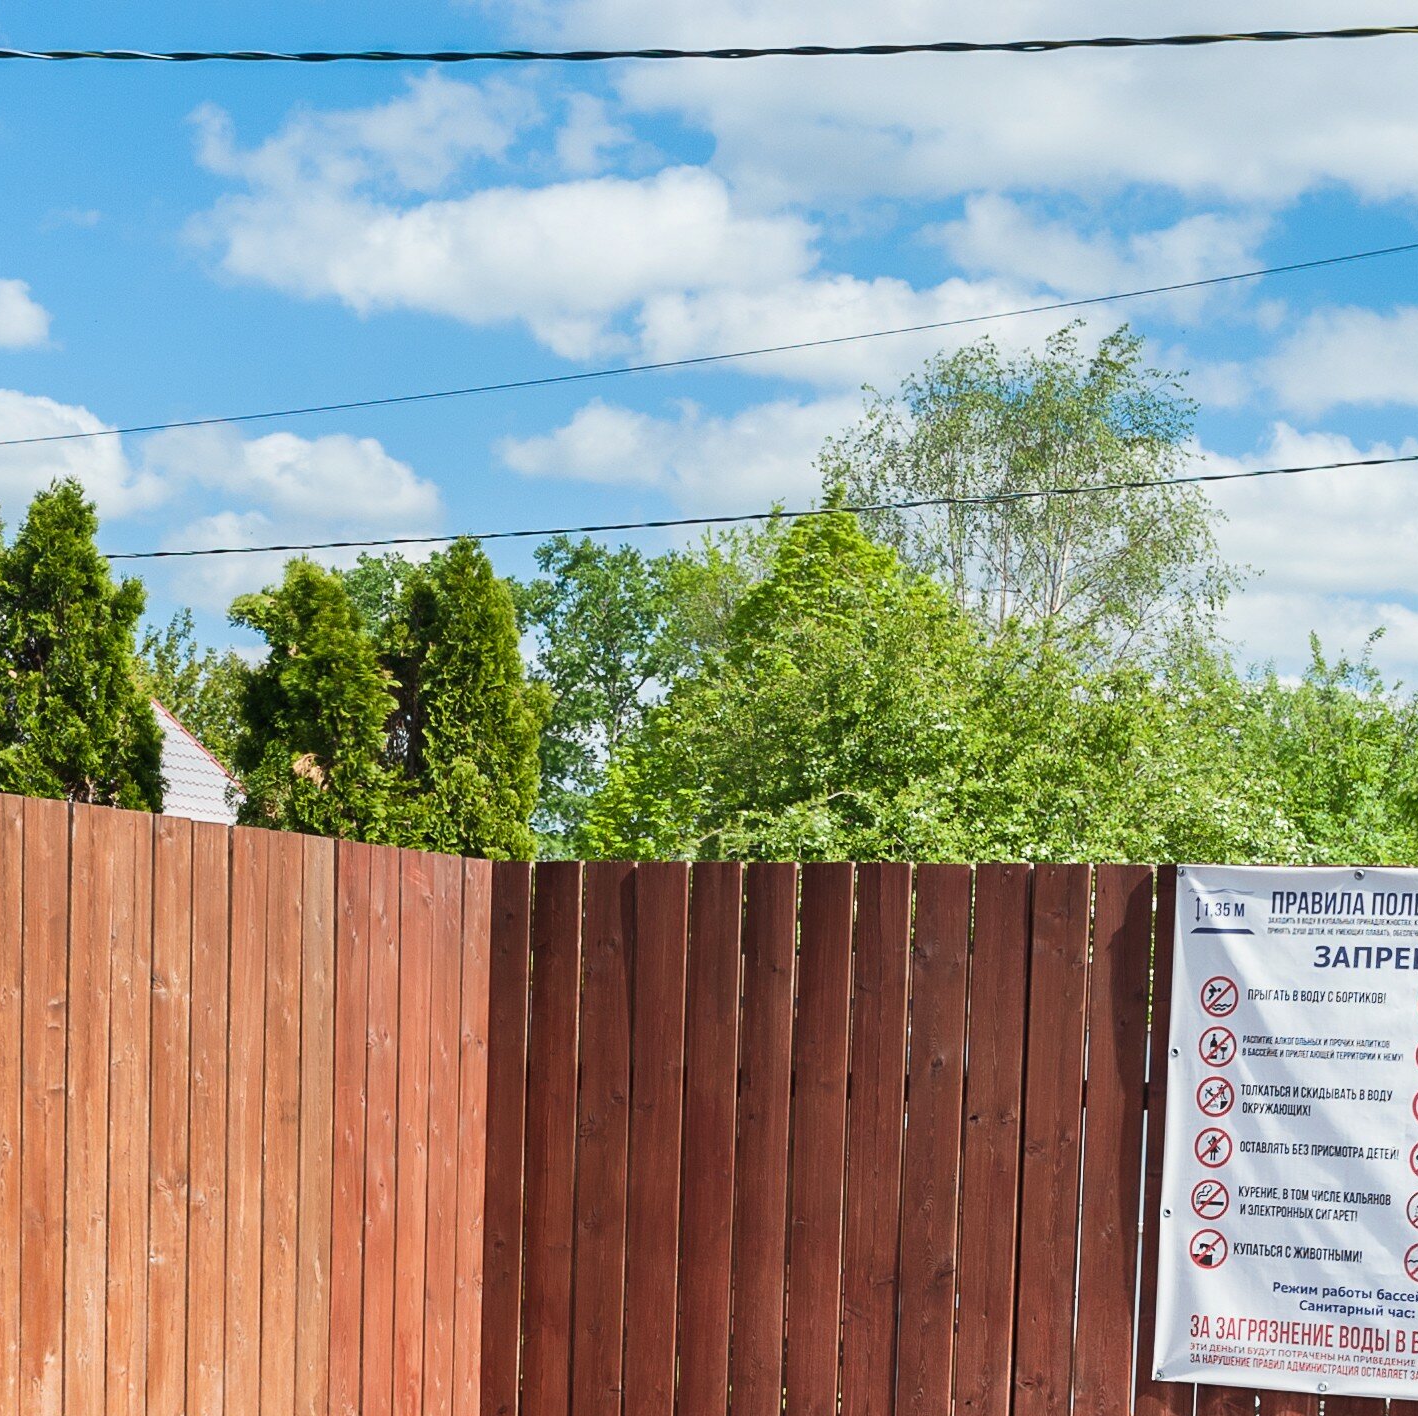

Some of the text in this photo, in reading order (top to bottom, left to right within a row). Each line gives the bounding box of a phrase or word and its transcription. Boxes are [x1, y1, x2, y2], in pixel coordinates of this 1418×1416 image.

[1203, 902, 1245, 918] 1,35 М
[1271, 890, 1364, 915] ПРАВИЛА
[1247, 988, 1386, 1004] ПРЫГАТЬ В ВОДУ С БОРТИКОВ!
[1242, 1035, 1390, 1048] РАСПИТИЕ АЛКОГОЛЬНЫХ И ПРОЧИХ НАПИТКОВ
[1247, 1049, 1279, 1058] БАССЕЙНЕ
[1279, 1050, 1284, 1058] И
[1285, 1050, 1335, 1059] ПРИЛЕГАЮЩЕЙ
[1336, 1052, 1376, 1061] ТЕРРИТОРИИ
[1377, 1053, 1381, 1061] К
[1383, 1053, 1403, 1062] НЕМУ!
[1241, 1084, 1393, 1101] ТОЛКАТЬСЯ И СКИДЫВАТЬ В ВОДУ
[1242, 1103, 1311, 1116] ОКРУЖАЮЩИХ!
[1240, 1141, 1399, 1160] ОСТАВЛЯТЬ БЕЗ ПРИСМОТРА ДЕТЕЙ!
[1238, 1186, 1391, 1205] КУРЕНИЕ, В ТОМ ЧИСЛЕ КАЛЬЯНОВ
[1239, 1204, 1358, 1222] И ЭЛЕКТРОННЫХ СИГАРЕТ!
[1233, 1243, 1362, 1263] КУПАТЬСЯ С ЖИВОТНЫМИ!
[1272, 1282, 1318, 1295] Режим
[1322, 1285, 1373, 1300] работы
[1299, 1300, 1384, 1318] Санитарный
[1388, 1308, 1415, 1319] час:
[1190, 1315, 1210, 1338] ЗА
[1216, 1317, 1333, 1347] ЗАГРЯЗНЕНИЕ
[1339, 1326, 1390, 1351] ВОДЫ
[1395, 1330, 1406, 1352] В
[1190, 1343, 1207, 1351] ЭТИ
[1209, 1344, 1245, 1354] ДЕНЬГИ
[1247, 1347, 1275, 1356] БУДУТ
[1278, 1349, 1336, 1361] ПОТРАЧЕНЫ
[1337, 1354, 1351, 1362] НА
[1353, 1355, 1415, 1367] ПРИВЕДЕНИЕ
[1190, 1354, 1200, 1365] ЗА
[1202, 1355, 1250, 1368] НАРУШЕНИЕ
[1252, 1359, 1285, 1371] ПРАВИЛ
[1287, 1361, 1359, 1376] АДМИНИСТРАЦИЯ
[1361, 1367, 1408, 1380] ОСТАВЛЯЕТ
